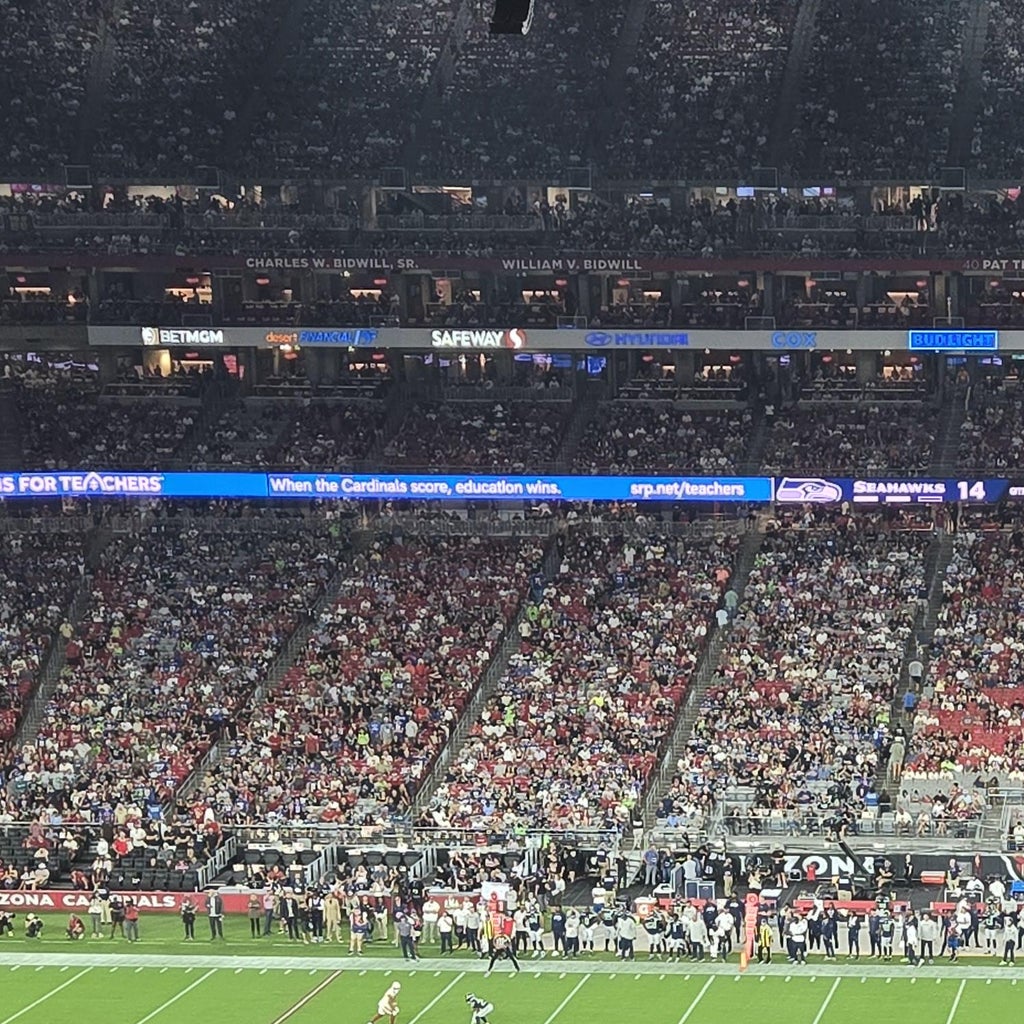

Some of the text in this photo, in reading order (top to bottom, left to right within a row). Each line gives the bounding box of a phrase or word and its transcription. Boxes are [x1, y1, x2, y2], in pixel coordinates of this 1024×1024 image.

[246, 258, 419, 270] CHARLES W. BIDWILL, SR.
[502, 259, 642, 270] WILLIAM V. BIDWILL
[982, 259, 1009, 269] PAT
[265, 331, 298, 342] desert
[299, 330, 352, 343] FINANCIAL
[431, 330, 503, 347] SAFEWAY
[772, 332, 817, 348] COX
[913, 334, 994, 347] BUD LIGHT
[18, 476, 57, 491] FOR
[59, 472, 162, 492] TEACHERS
[270, 478, 561, 495] When the Cardinals score, education wins.
[853, 481, 945, 494] SEAHAWKS
[630, 482, 745, 498] srp.net/teachers
[957, 482, 986, 500] 14
